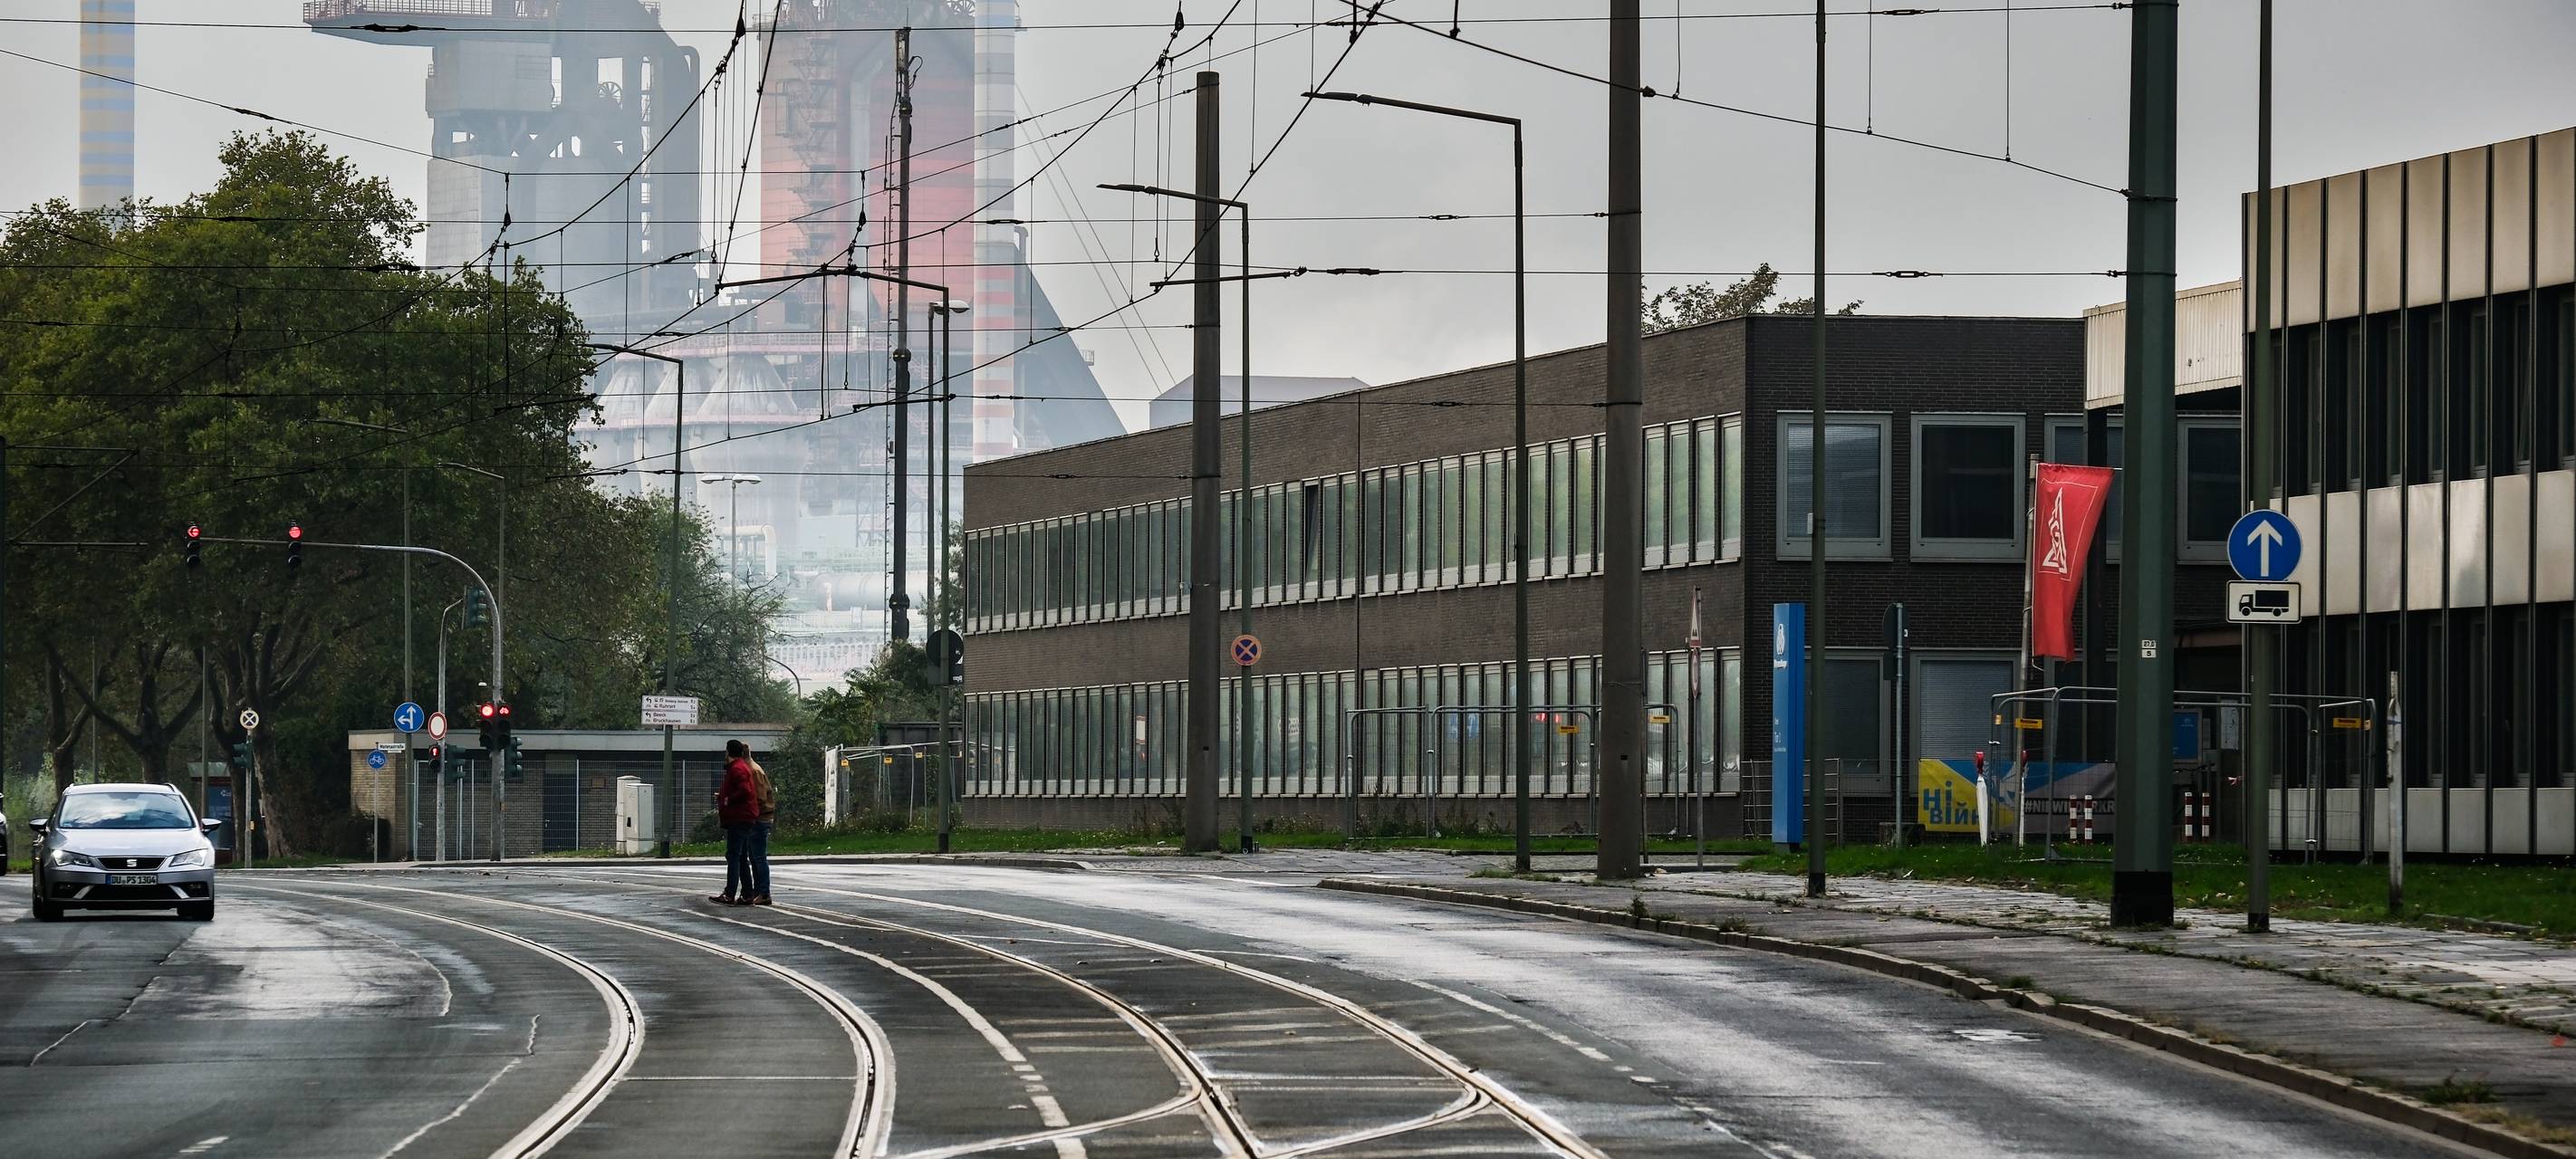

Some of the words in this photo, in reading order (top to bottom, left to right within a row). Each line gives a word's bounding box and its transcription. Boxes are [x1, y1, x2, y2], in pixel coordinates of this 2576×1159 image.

[111, 876, 122, 885] DU
[127, 876, 136, 885] PS
[137, 876, 156, 885] 1304
